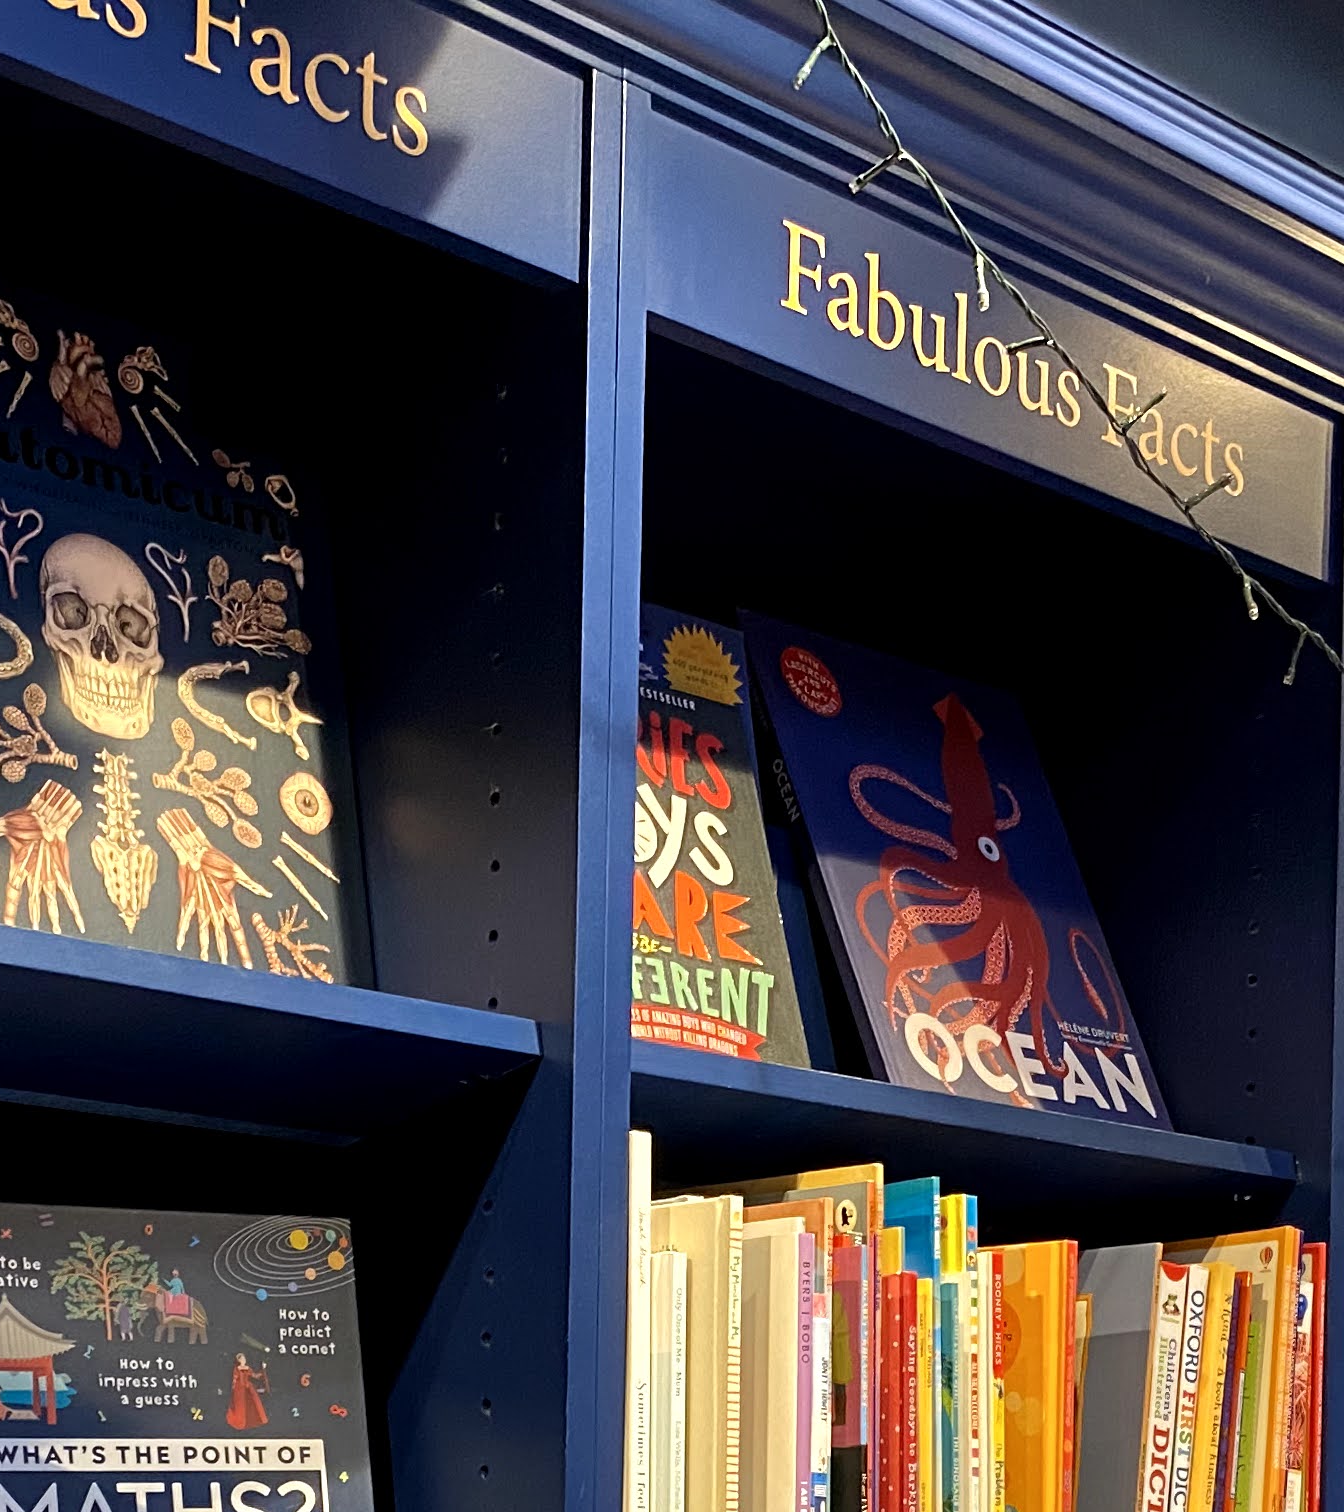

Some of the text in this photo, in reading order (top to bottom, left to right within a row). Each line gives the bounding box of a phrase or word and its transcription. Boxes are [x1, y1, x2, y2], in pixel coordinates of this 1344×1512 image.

[184, 0, 428, 156] Facts
[781, 219, 1245, 497] Fabulous Facts
[902, 1011, 1158, 1119] OCEAN
[1183, 1287, 1207, 1387] OXFORD
[116, 1444, 170, 1464] THE
[182, 1446, 267, 1464] POINT
[276, 1446, 312, 1464] OF
[1175, 1389, 1197, 1463] FIRST
